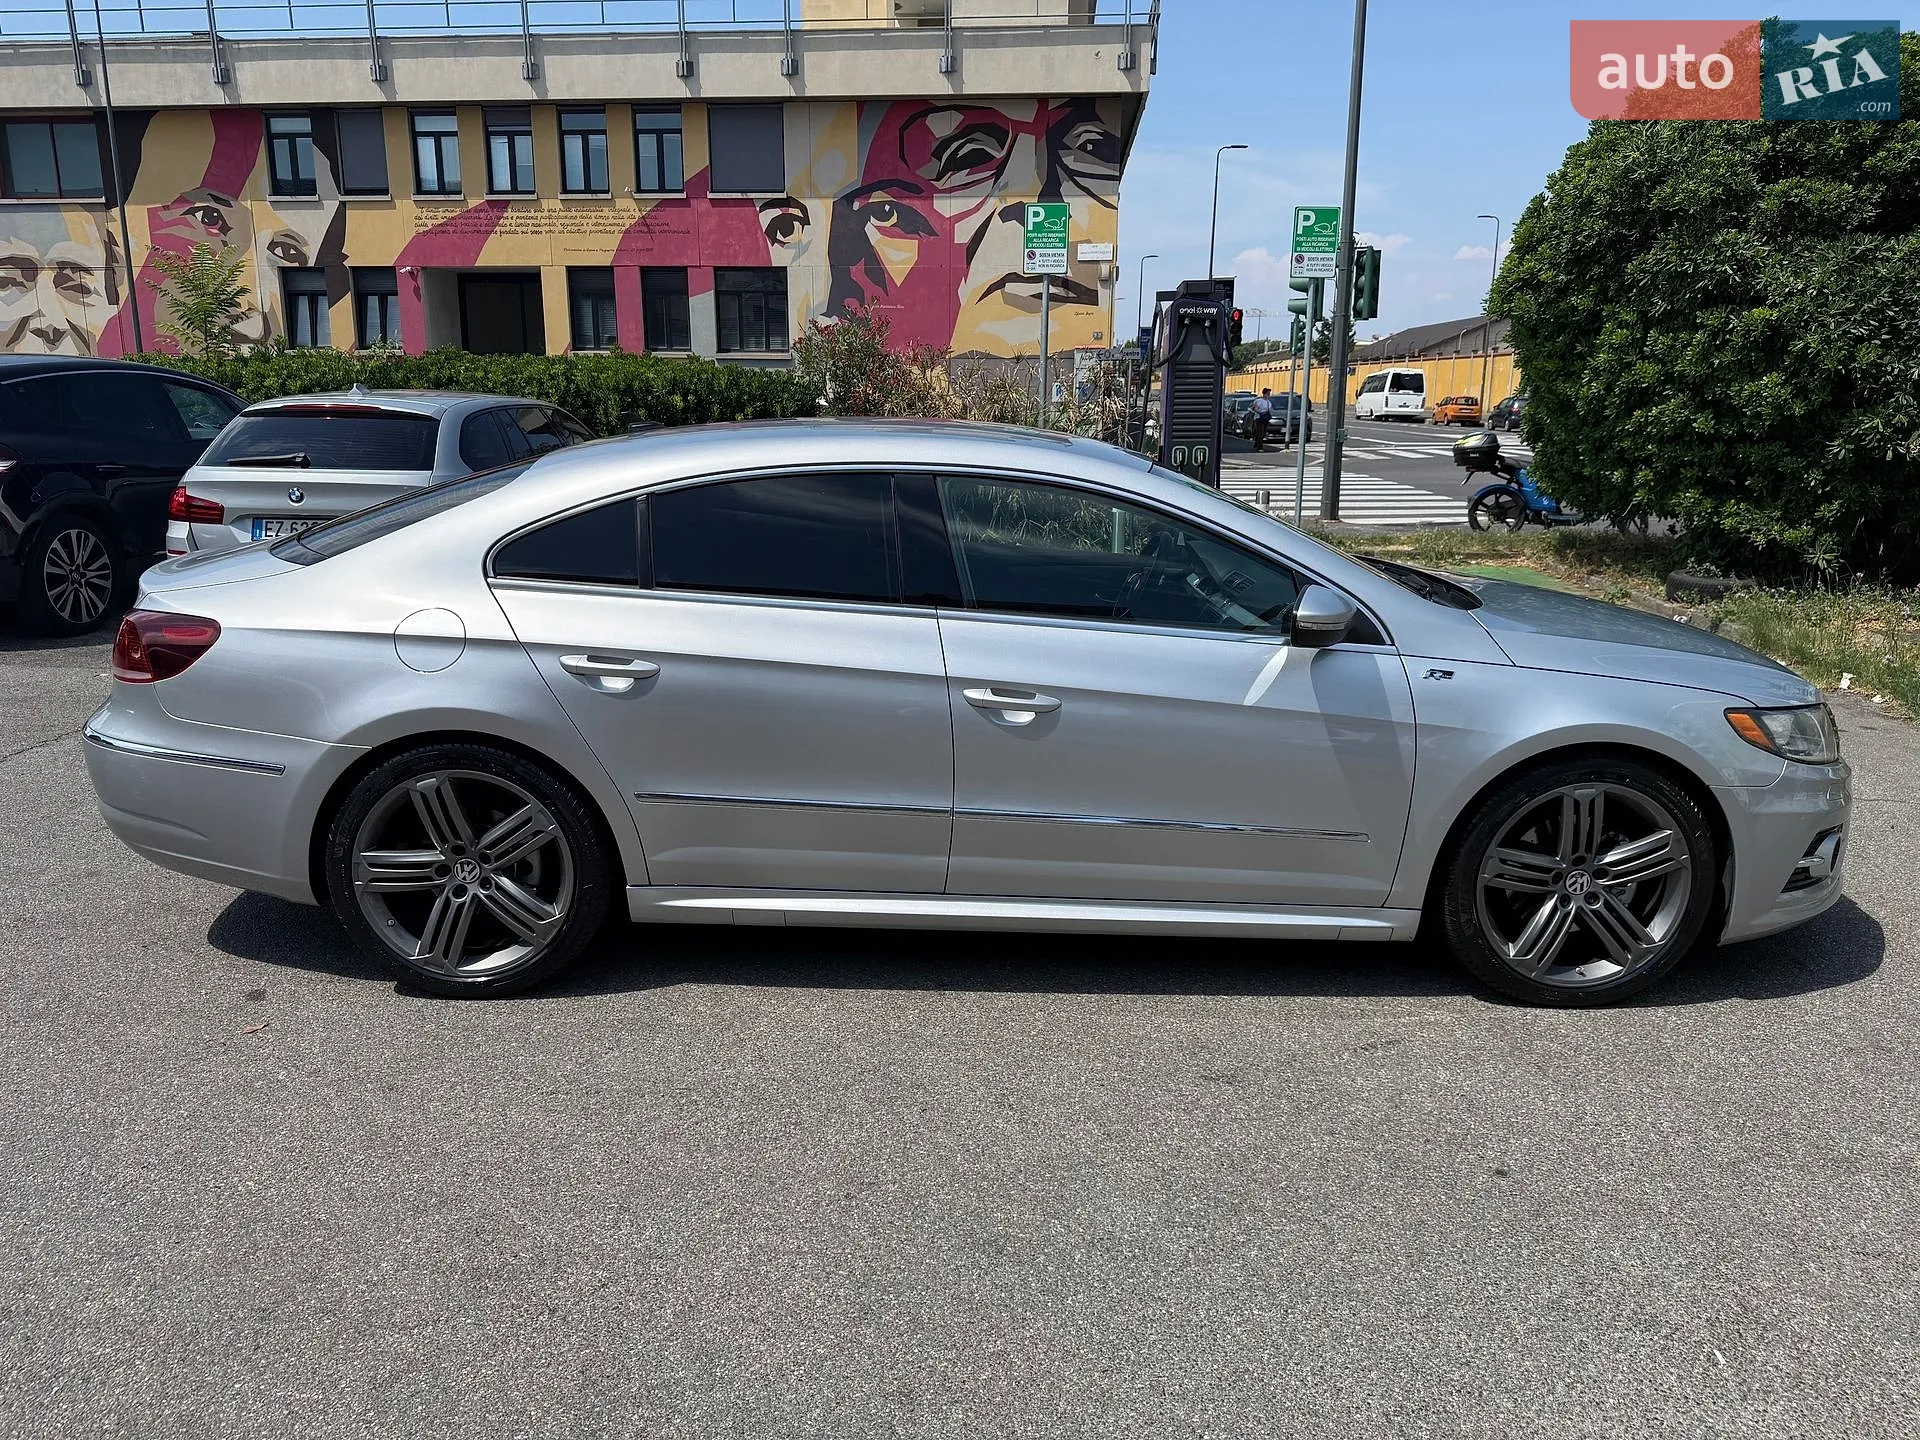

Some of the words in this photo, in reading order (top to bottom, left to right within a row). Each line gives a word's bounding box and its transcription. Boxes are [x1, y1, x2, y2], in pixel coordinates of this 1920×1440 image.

[1028, 206, 1045, 230] P
[1297, 210, 1315, 234] P
[1180, 306, 1195, 314] enel
[1203, 307, 1218, 315] way
[265, 521, 284, 537] EZ
